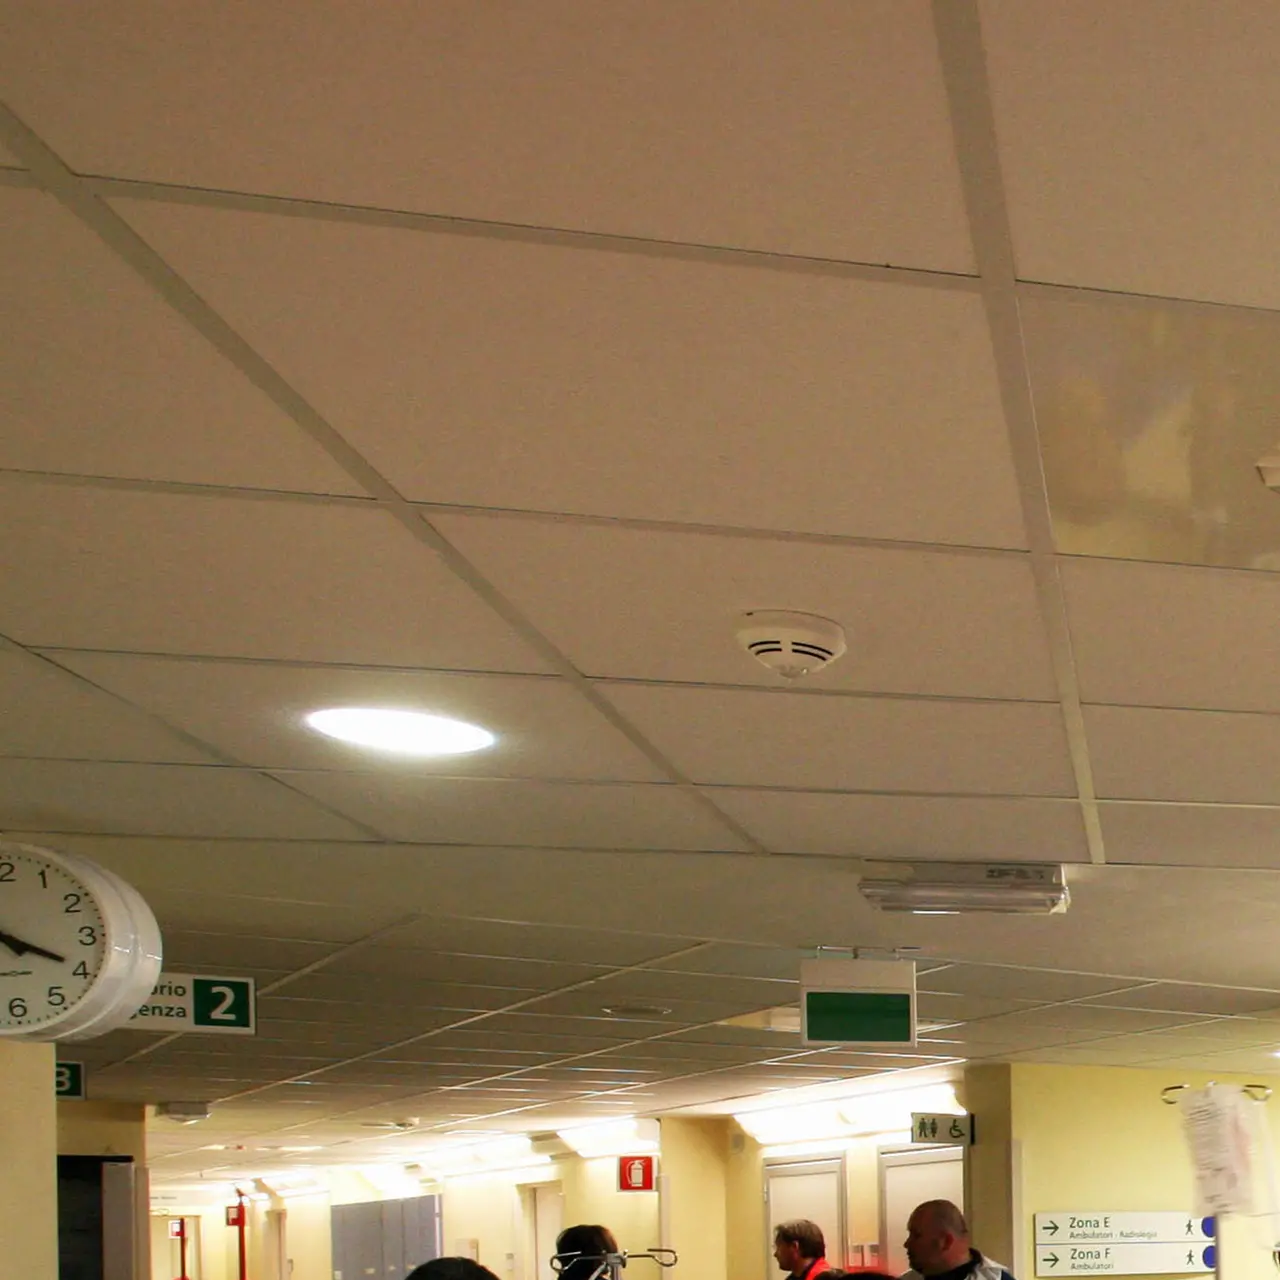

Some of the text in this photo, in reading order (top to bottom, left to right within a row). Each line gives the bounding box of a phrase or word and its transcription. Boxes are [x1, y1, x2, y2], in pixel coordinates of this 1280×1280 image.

[37, 869, 48, 889] 1
[63, 893, 82, 914] 2
[78, 926, 97, 946] 3
[72, 961, 91, 980] 4
[47, 986, 66, 1006] 5
[210, 986, 237, 1020] 2
[8, 998, 28, 1018] 6
[1069, 1217, 1111, 1229] Zona E
[1070, 1248, 1111, 1260] Zona F
[1070, 1262, 1114, 1271] Ambulatori
